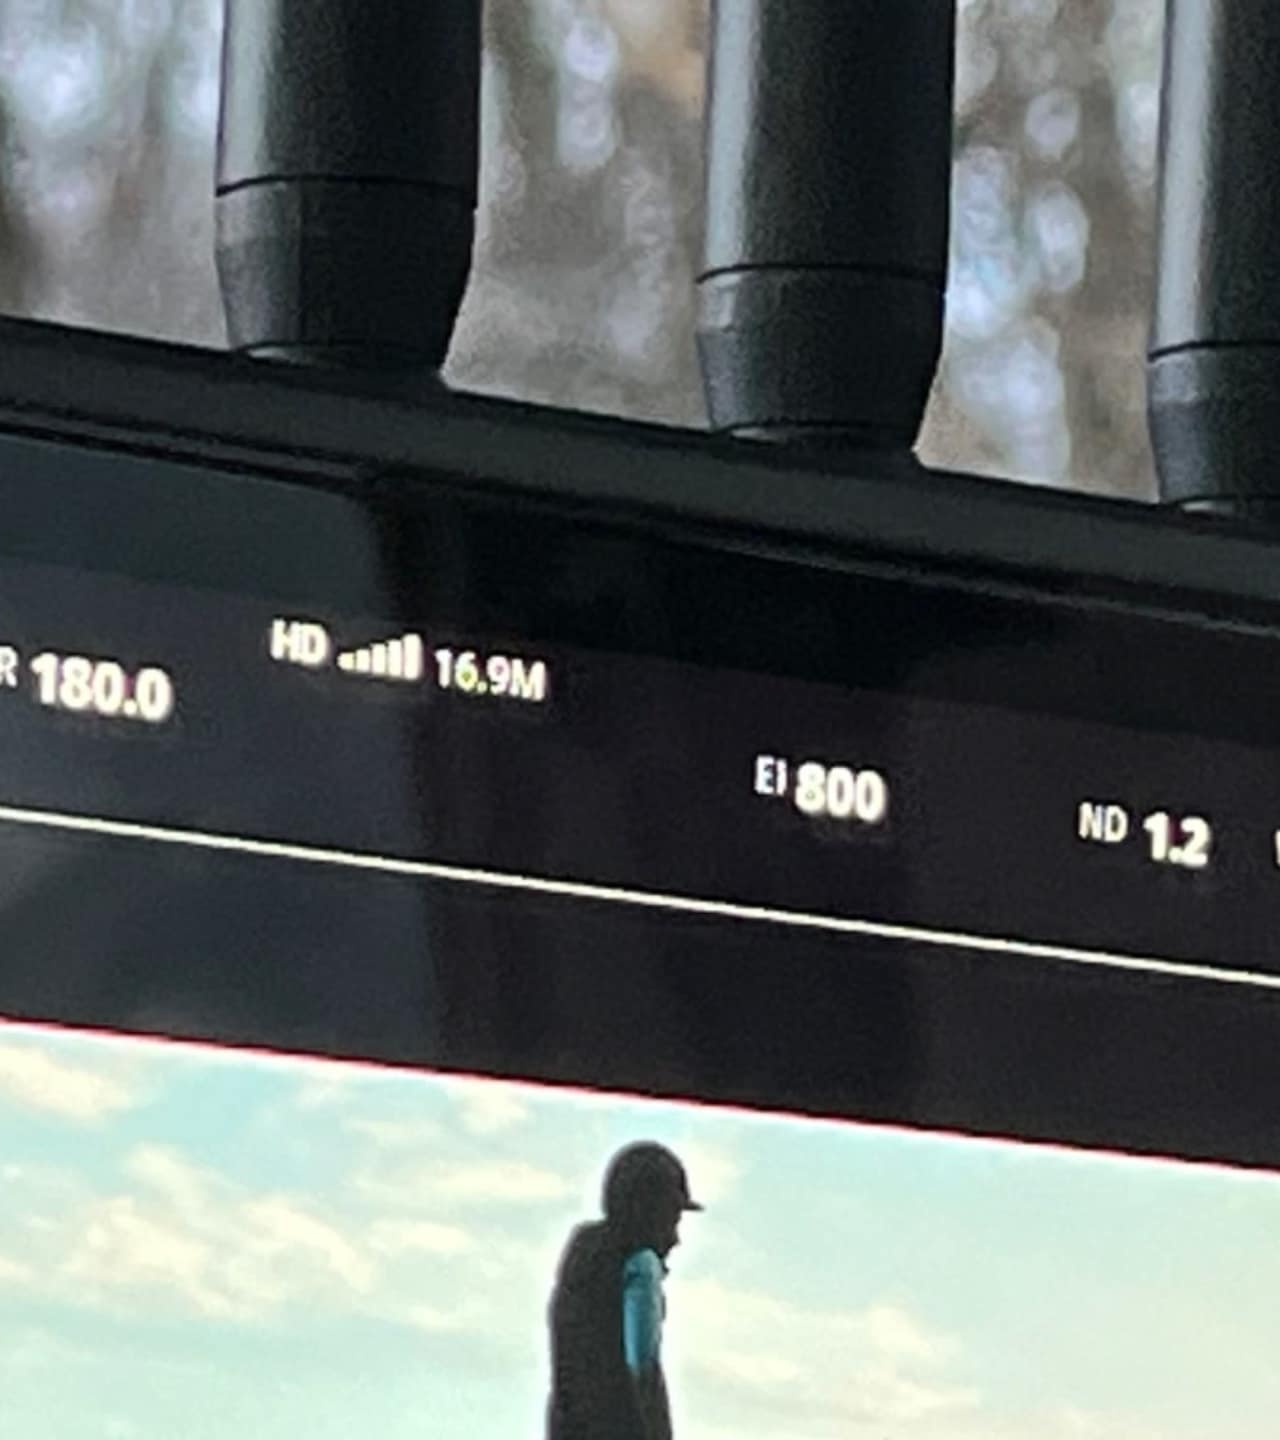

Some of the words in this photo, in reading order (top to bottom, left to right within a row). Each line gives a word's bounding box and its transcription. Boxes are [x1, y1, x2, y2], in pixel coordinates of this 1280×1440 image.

[271, 618, 328, 664] HD
[29, 652, 174, 722] 180.0
[435, 649, 547, 702] 16.9M
[755, 755, 787, 795] EI
[794, 762, 887, 823] 800
[1079, 802, 1129, 842] ND
[1143, 811, 1210, 867] 1.2
